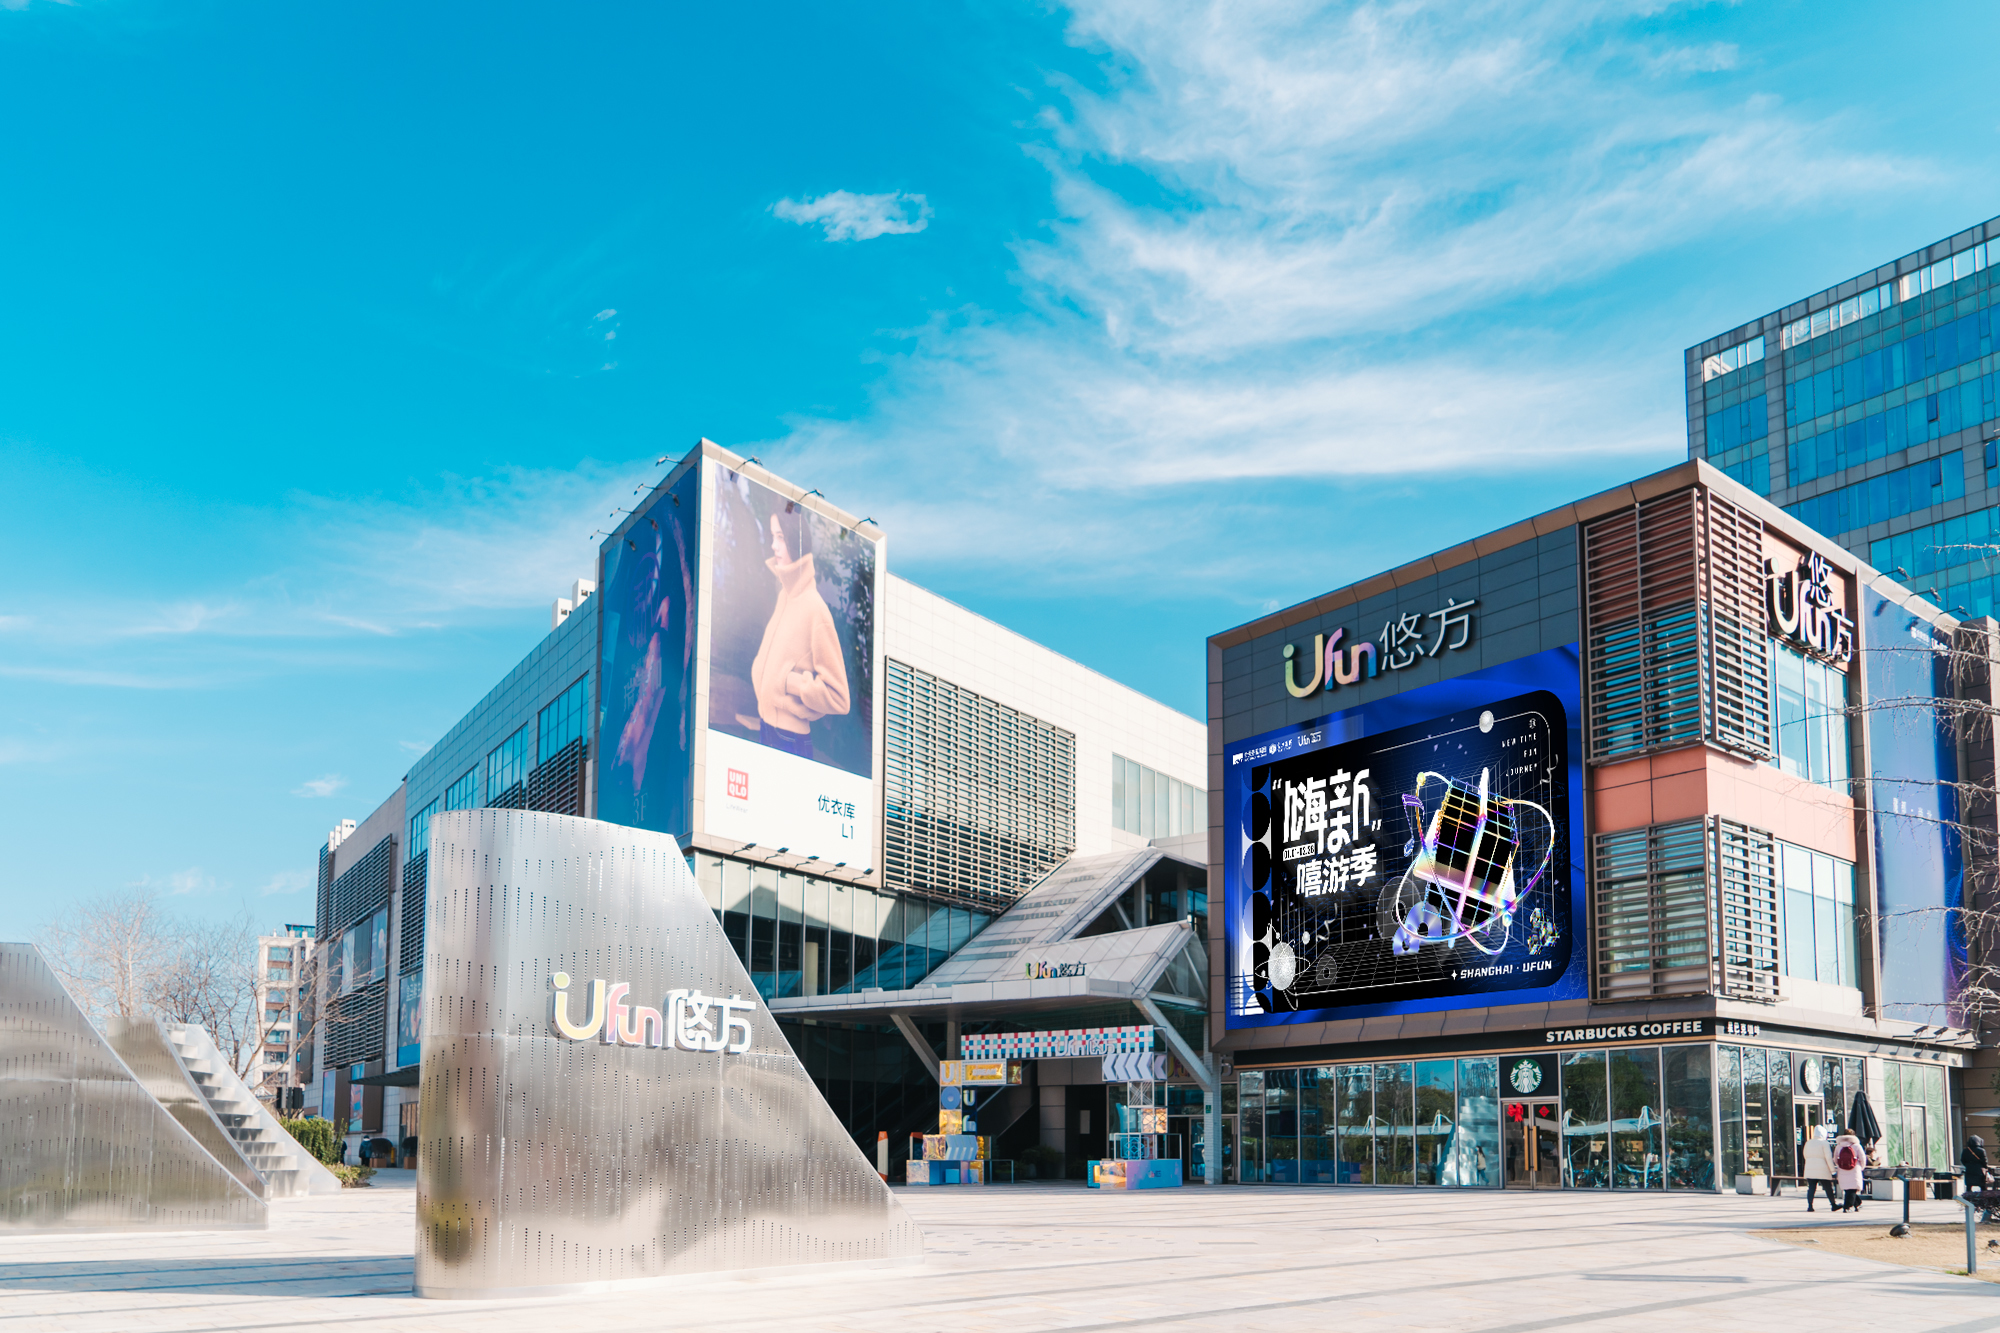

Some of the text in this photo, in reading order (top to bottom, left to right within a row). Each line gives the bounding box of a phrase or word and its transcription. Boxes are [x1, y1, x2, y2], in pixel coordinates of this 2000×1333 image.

[1378, 597, 1476, 671] 悠方
[818, 794, 856, 820] 优衣库
[1460, 960, 1552, 979] SHANGHAI UFUN
[1545, 1020, 1702, 1043] STARBUCKS COFFEE
